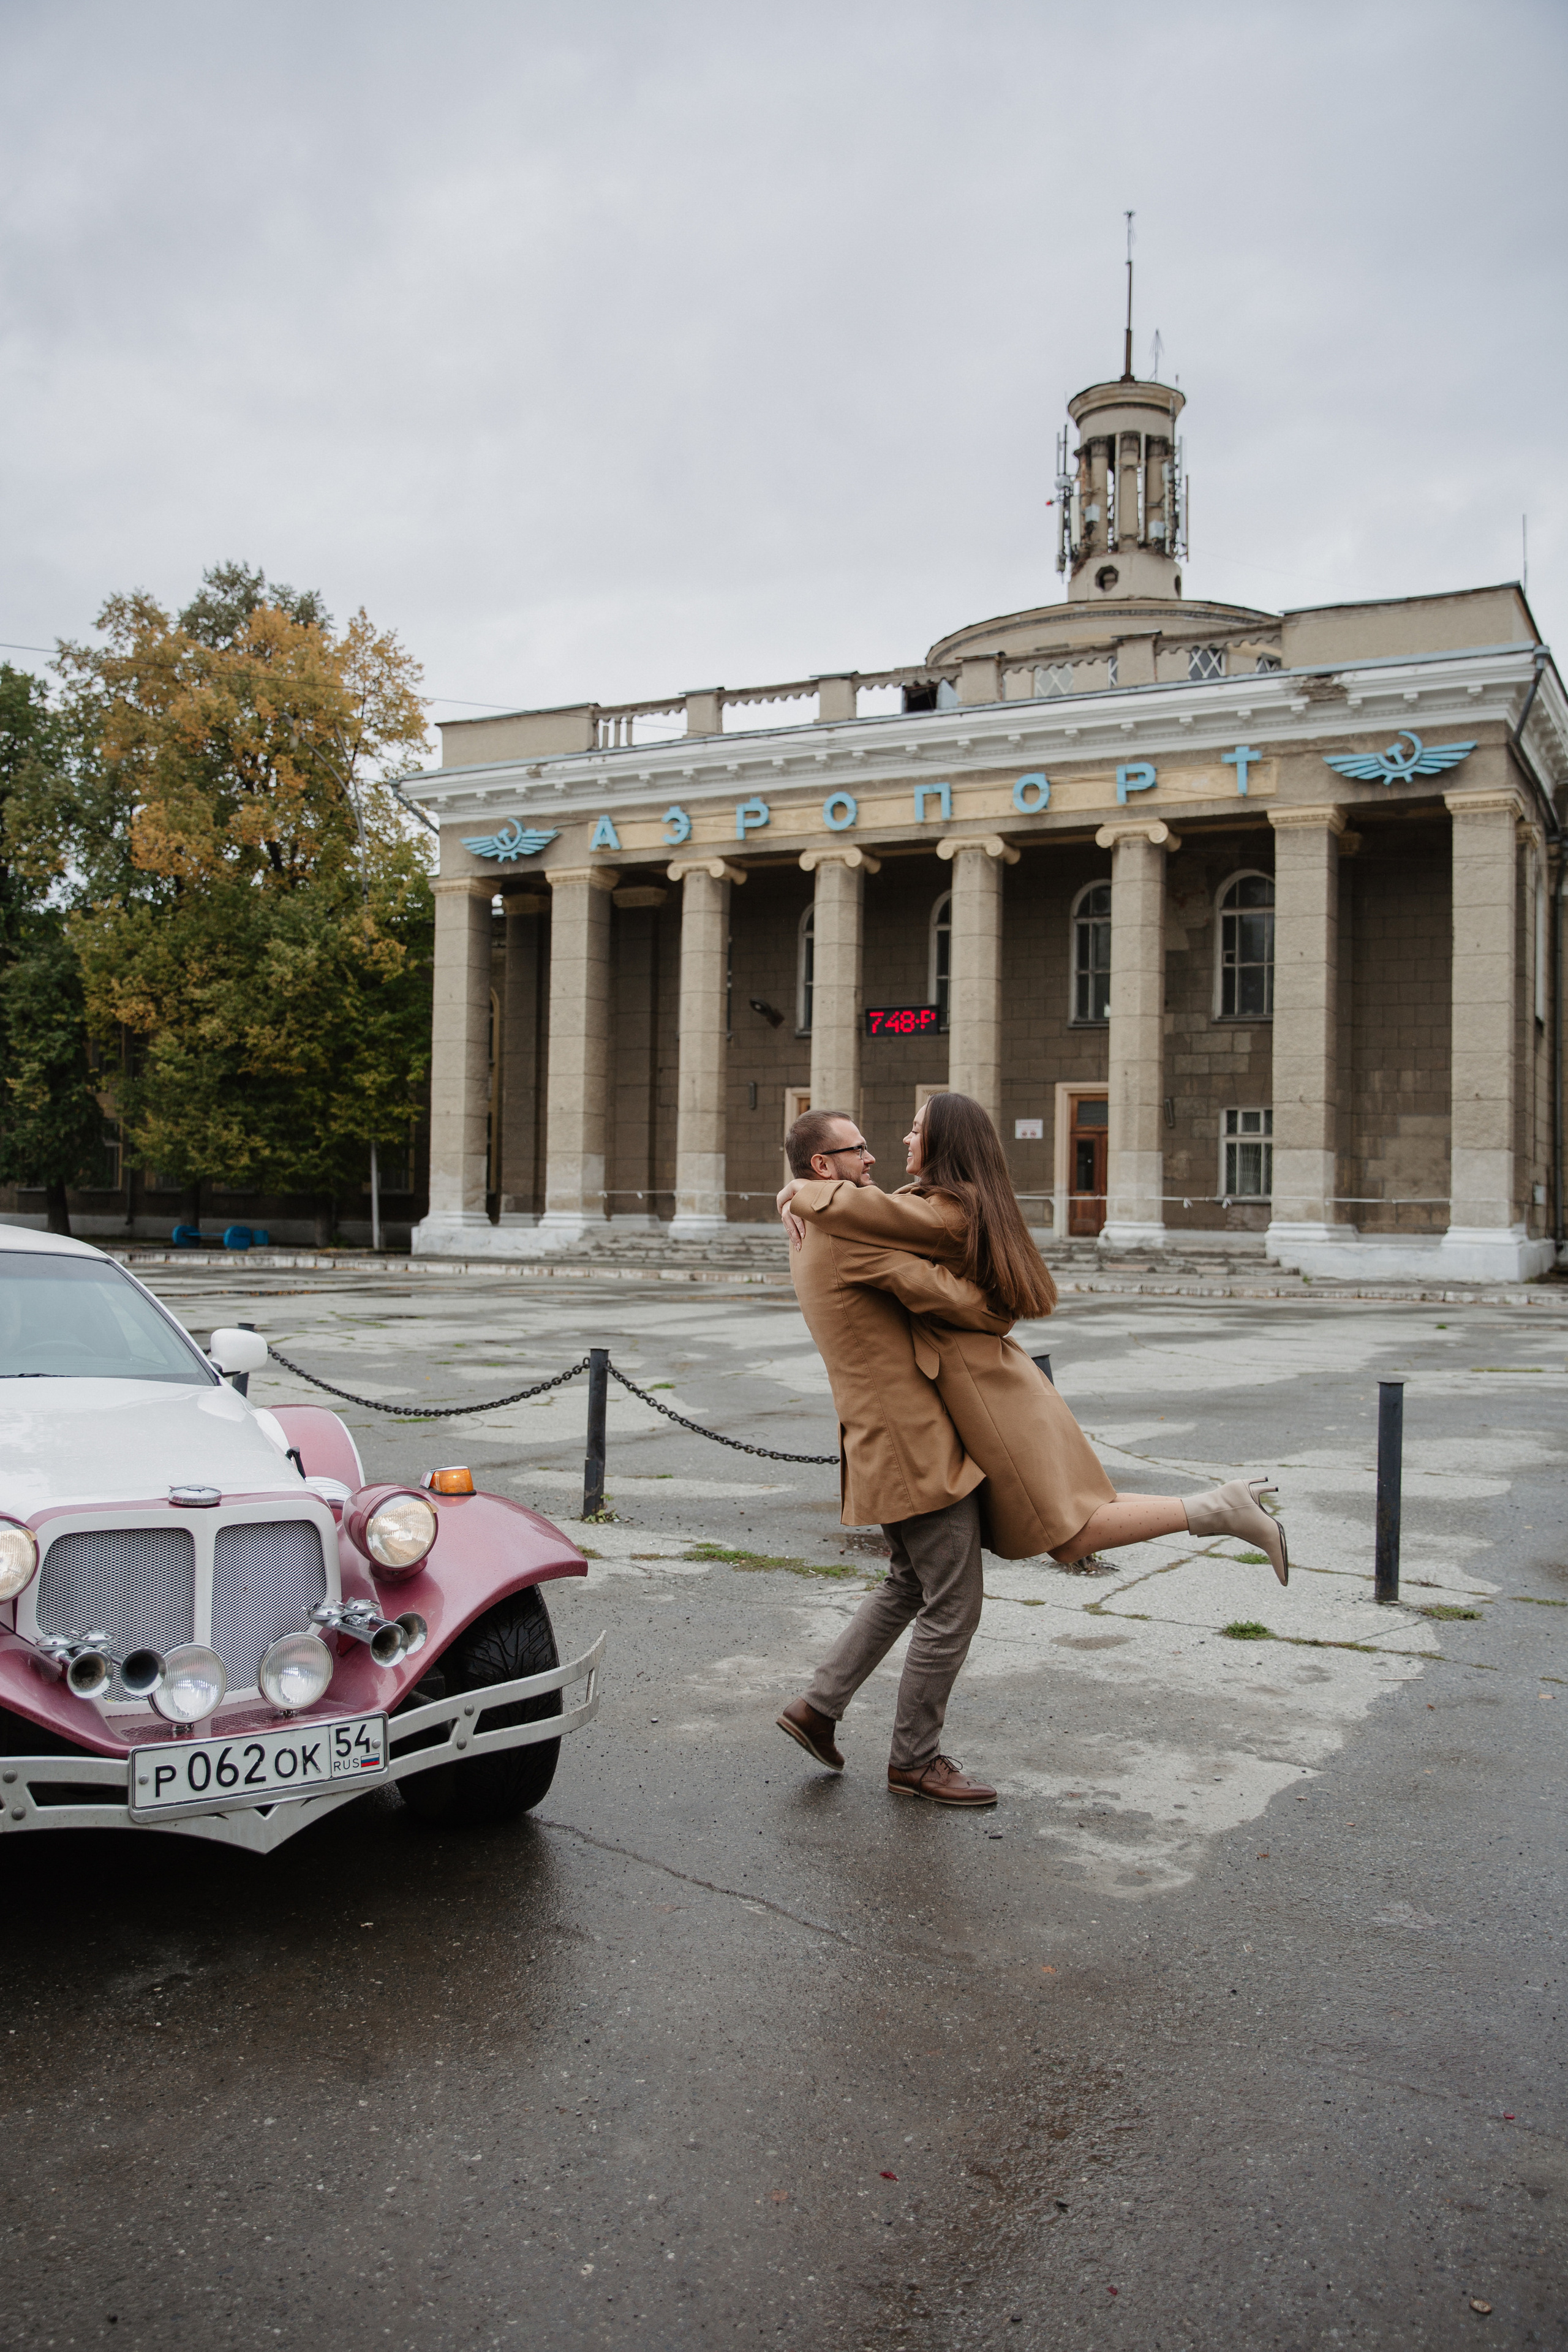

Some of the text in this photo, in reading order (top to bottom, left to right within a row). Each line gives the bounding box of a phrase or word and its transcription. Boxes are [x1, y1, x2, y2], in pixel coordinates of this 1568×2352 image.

[590, 746, 1262, 851] АЭРОПОРТ
[336, 1724, 370, 1757] 54
[334, 1758, 360, 1771] RUS
